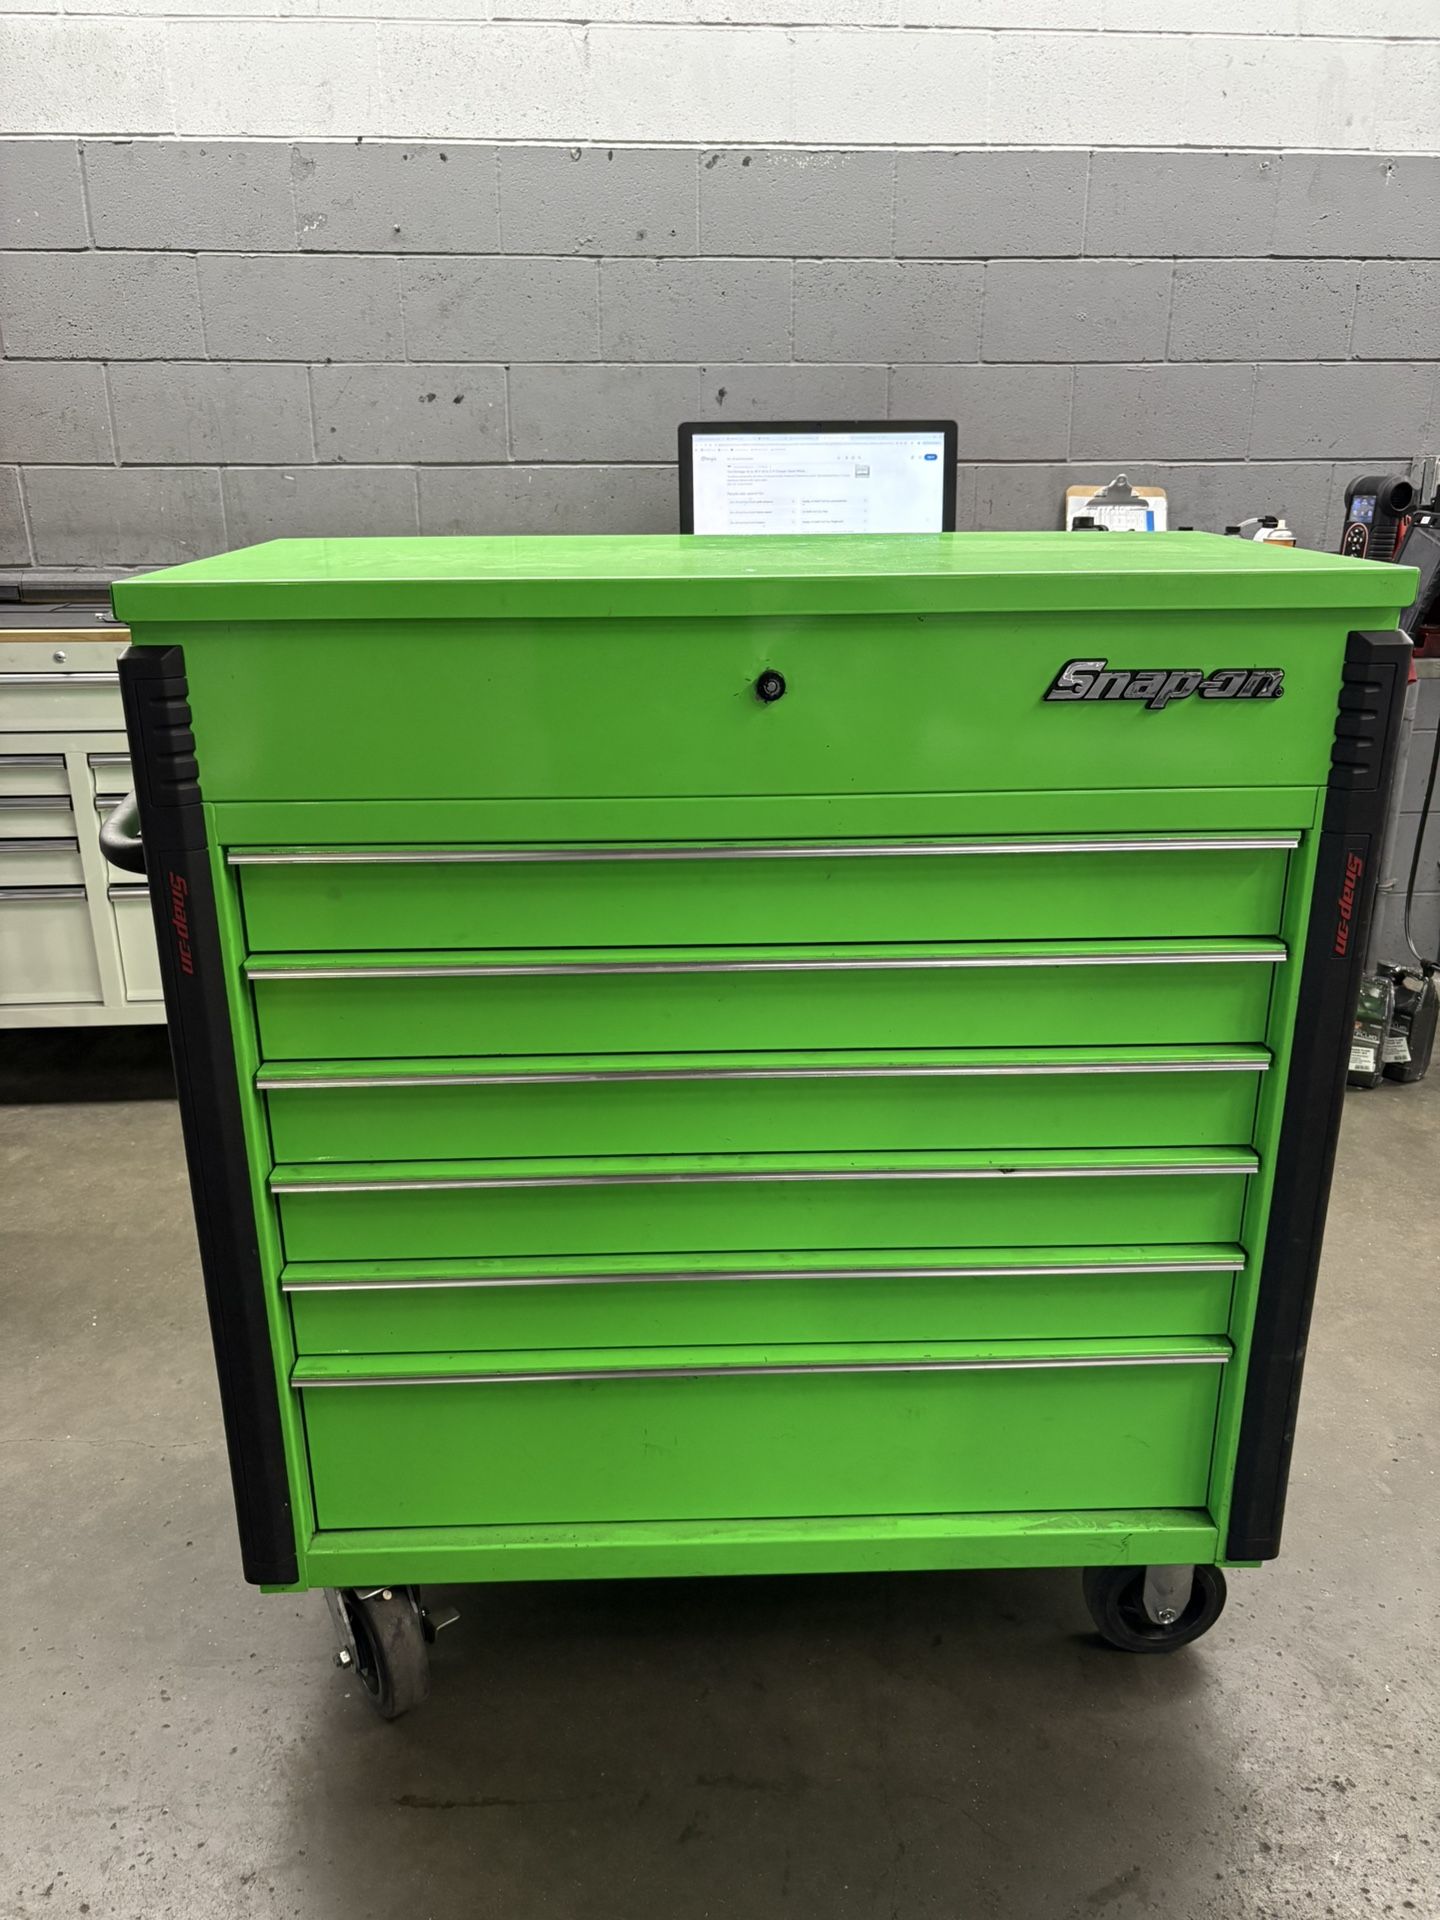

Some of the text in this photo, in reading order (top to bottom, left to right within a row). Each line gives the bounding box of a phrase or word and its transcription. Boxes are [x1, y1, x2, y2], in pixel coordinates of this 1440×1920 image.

[1044, 658, 1283, 709] Snap-on
[169, 872, 193, 975] Snap-on
[1334, 854, 1363, 955] Snap-on
